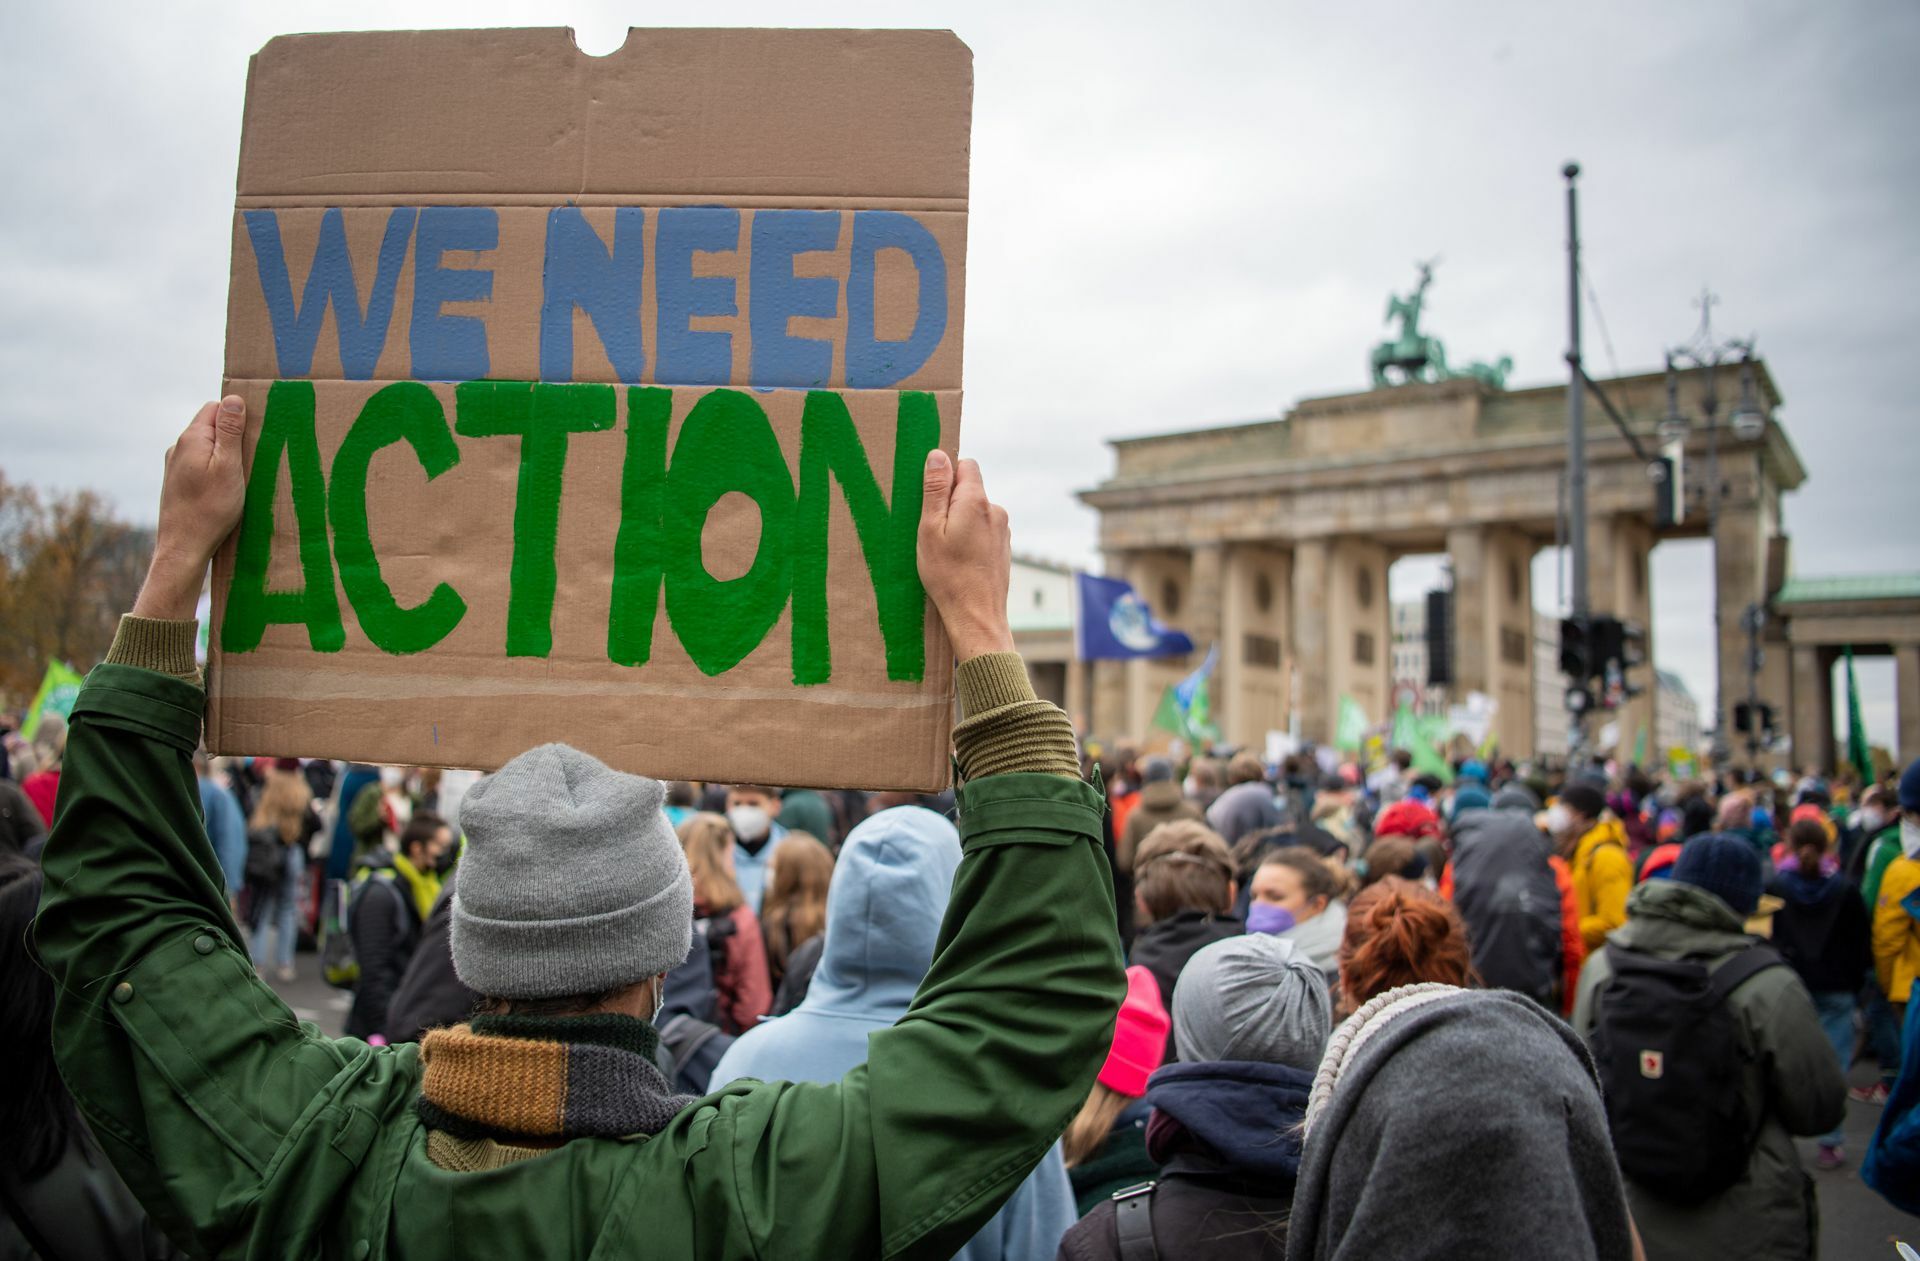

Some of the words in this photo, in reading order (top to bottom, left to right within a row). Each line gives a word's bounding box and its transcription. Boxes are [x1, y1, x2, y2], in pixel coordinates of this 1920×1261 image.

[243, 205, 500, 381] WE
[539, 204, 948, 390] NEED
[221, 379, 941, 686] ACTION
